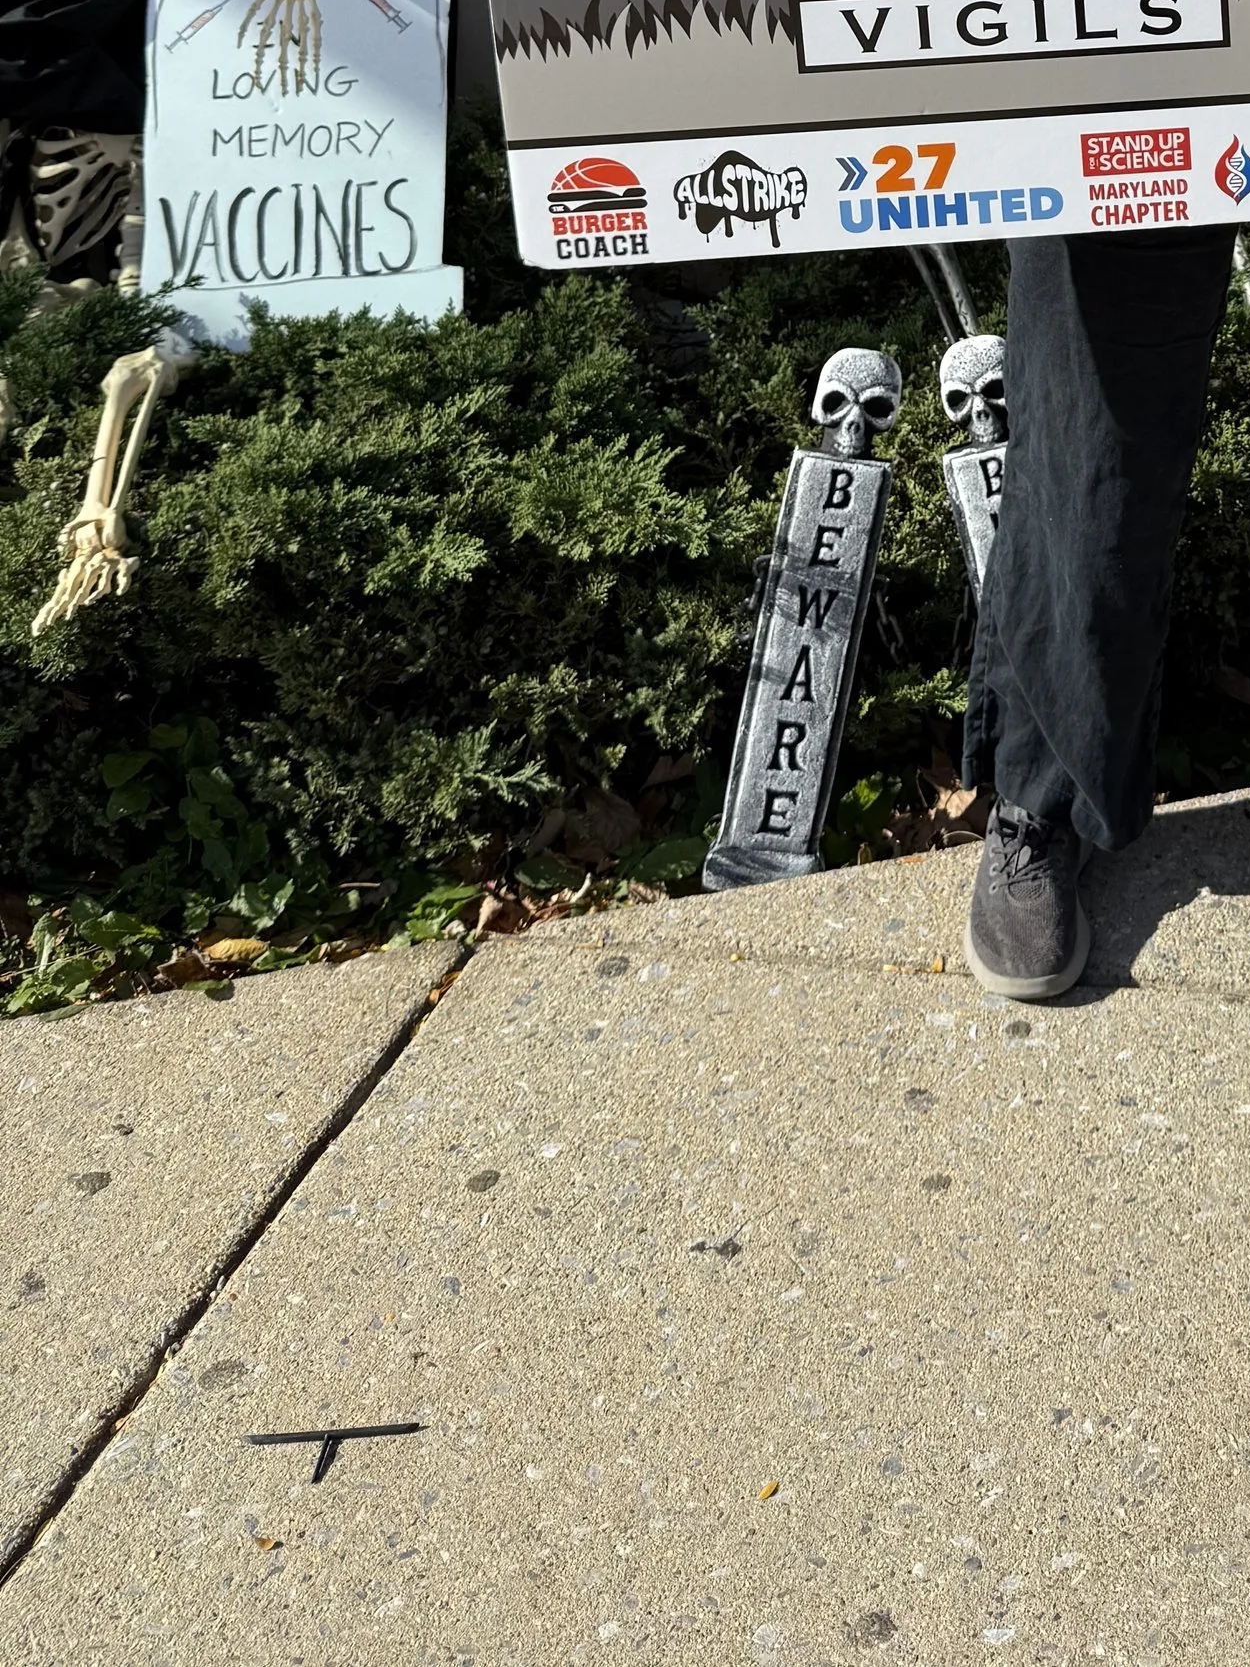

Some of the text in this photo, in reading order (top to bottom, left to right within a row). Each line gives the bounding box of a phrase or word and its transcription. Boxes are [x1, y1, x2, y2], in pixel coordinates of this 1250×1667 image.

[212, 118, 394, 157] MEMORY
[1087, 132, 1185, 154] STAND UP
[874, 142, 956, 193] 27
[1099, 150, 1184, 171] SCIENCE
[1089, 178, 1189, 201] MARYLAND
[839, 187, 1064, 233] UNIHTED
[1090, 200, 1189, 226] CHAPTER
[158, 178, 418, 283] VACCINES
[552, 212, 648, 235] BURGER
[556, 234, 650, 260] COACH
[755, 468, 855, 836] BEWARE
